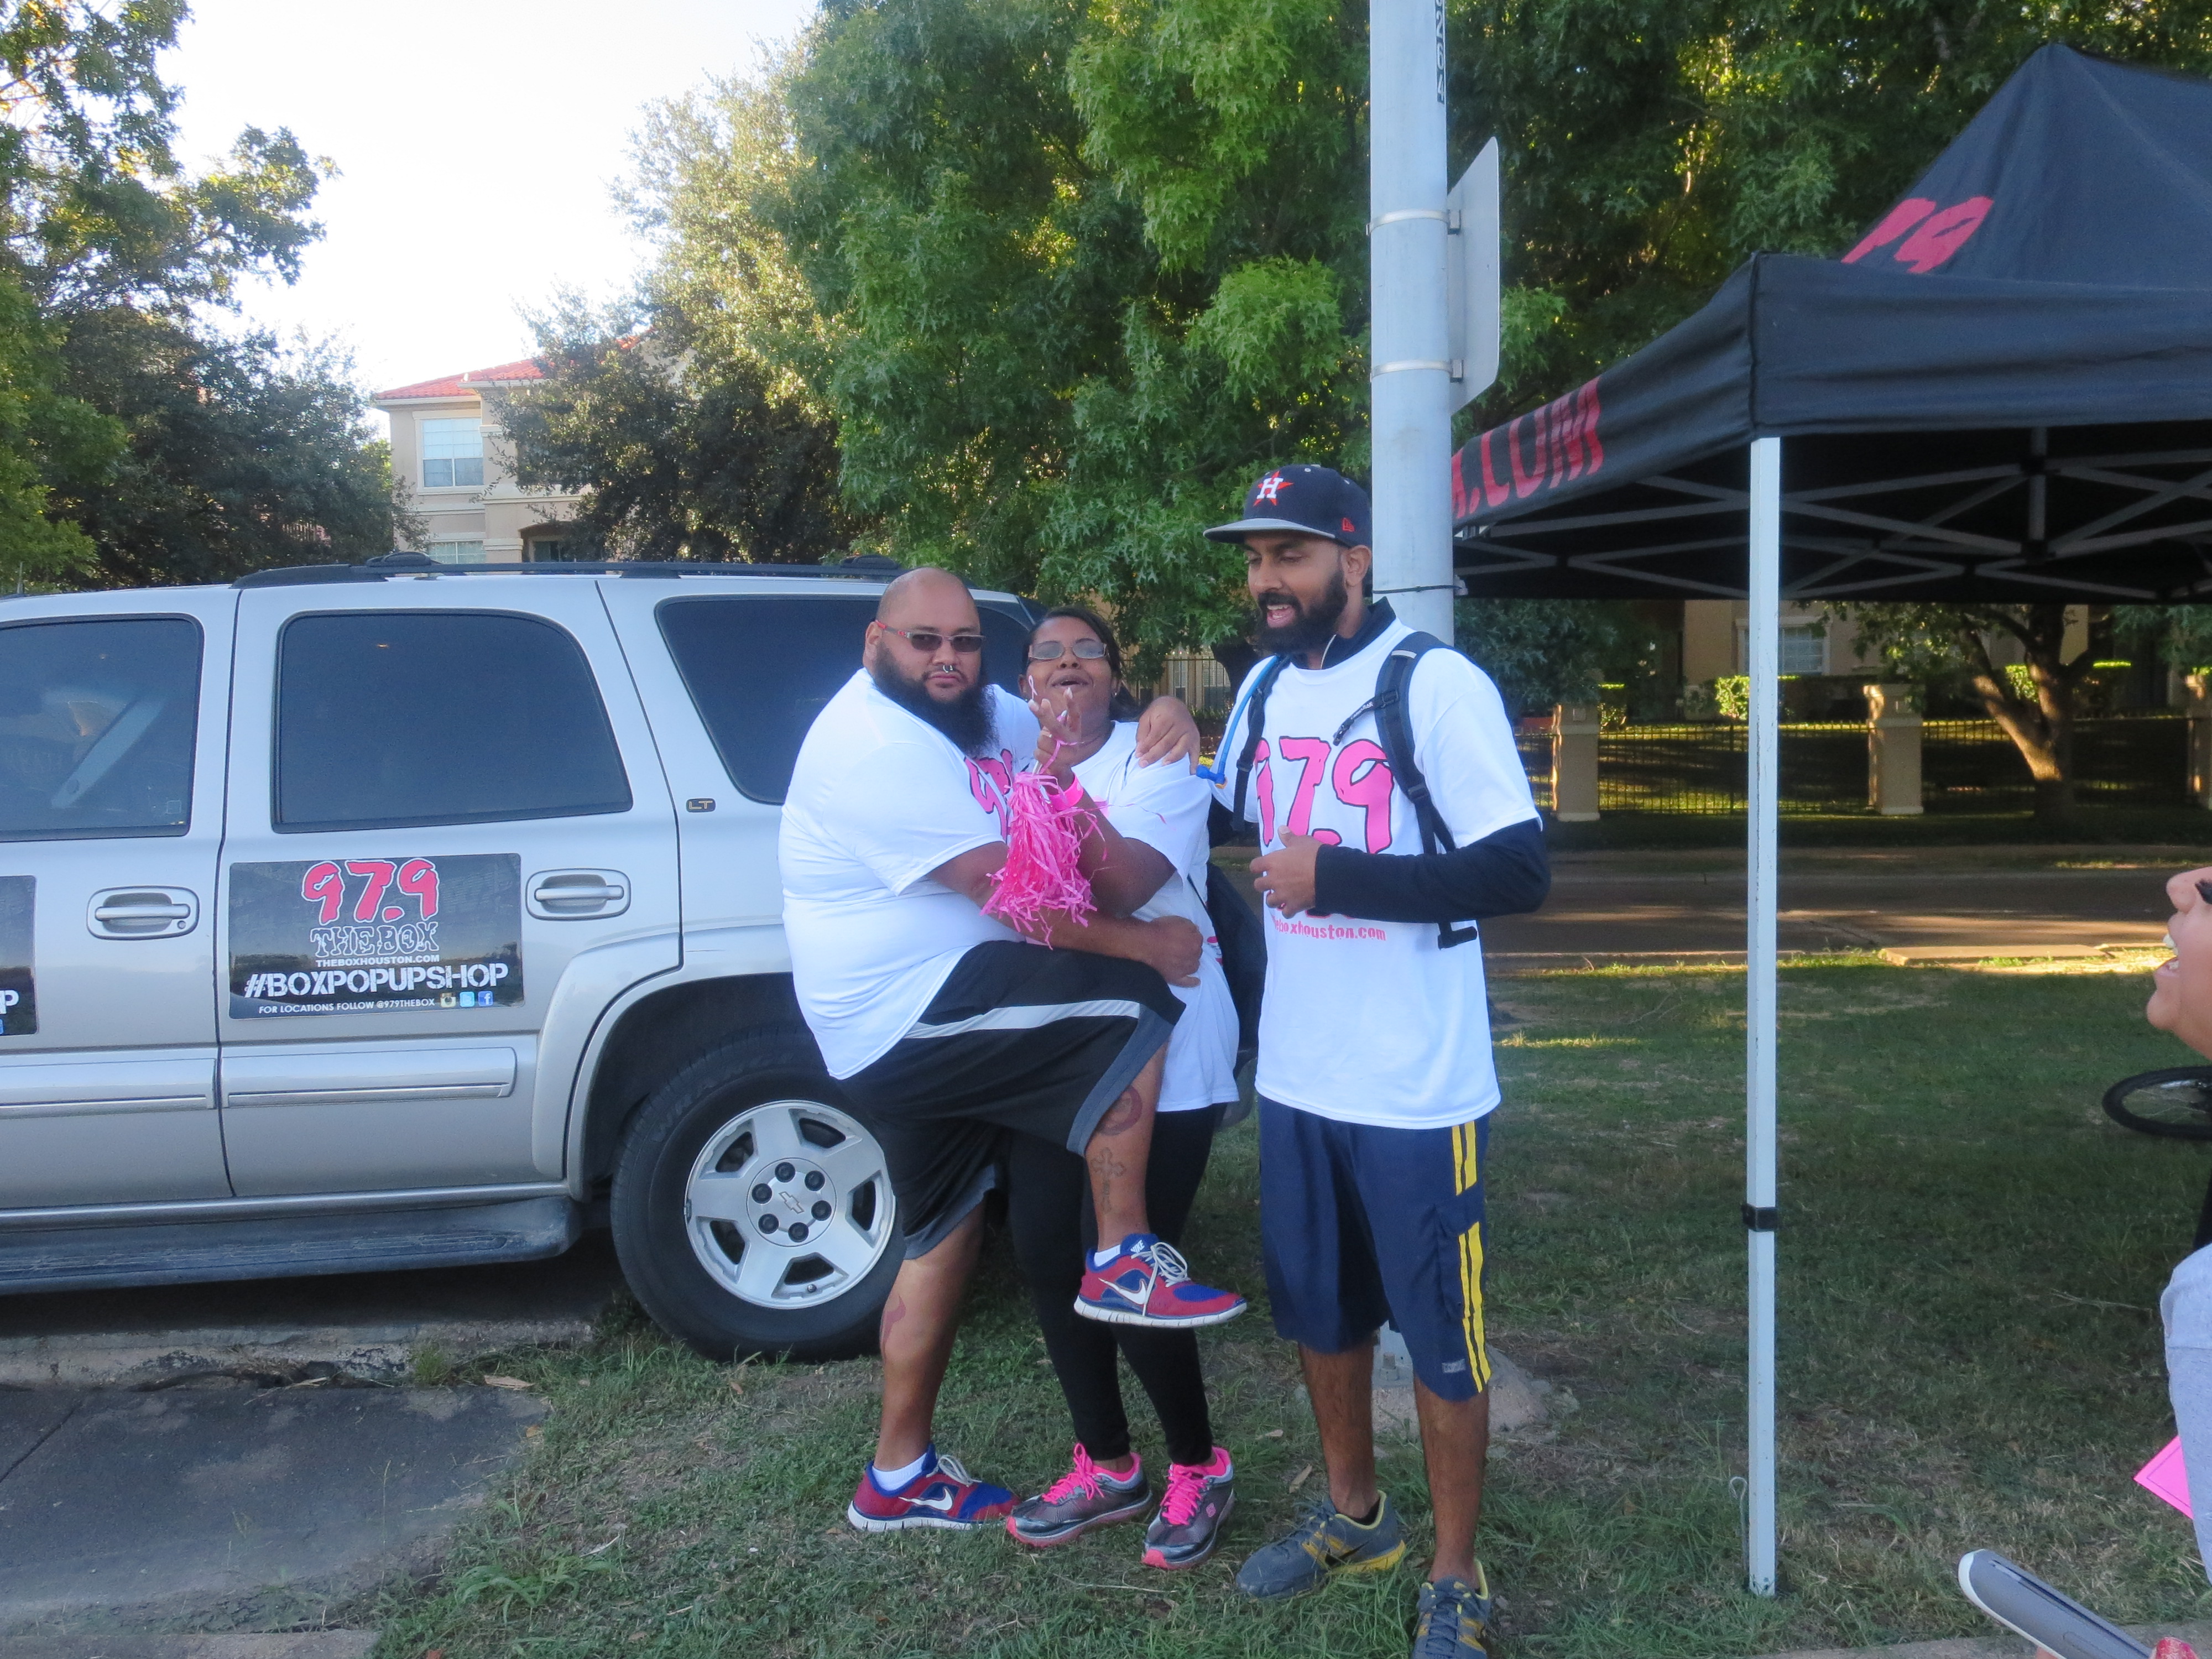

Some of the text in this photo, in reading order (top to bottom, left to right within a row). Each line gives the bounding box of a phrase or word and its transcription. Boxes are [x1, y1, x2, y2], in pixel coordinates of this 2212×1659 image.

[688, 800, 713, 810] LT
[302, 858, 440, 925] 97.9
[310, 921, 440, 958] THE BOX
[315, 954, 440, 968] THEBOXHOUSTON.COM
[244, 963, 509, 998] #BOXPOPUPSHOP
[258, 1006, 278, 1014] FOR
[280, 1003, 335, 1013] LOCATIONS
[336, 1001, 374, 1010] FOLLOW
[376, 998, 435, 1009] @979THEBOX
